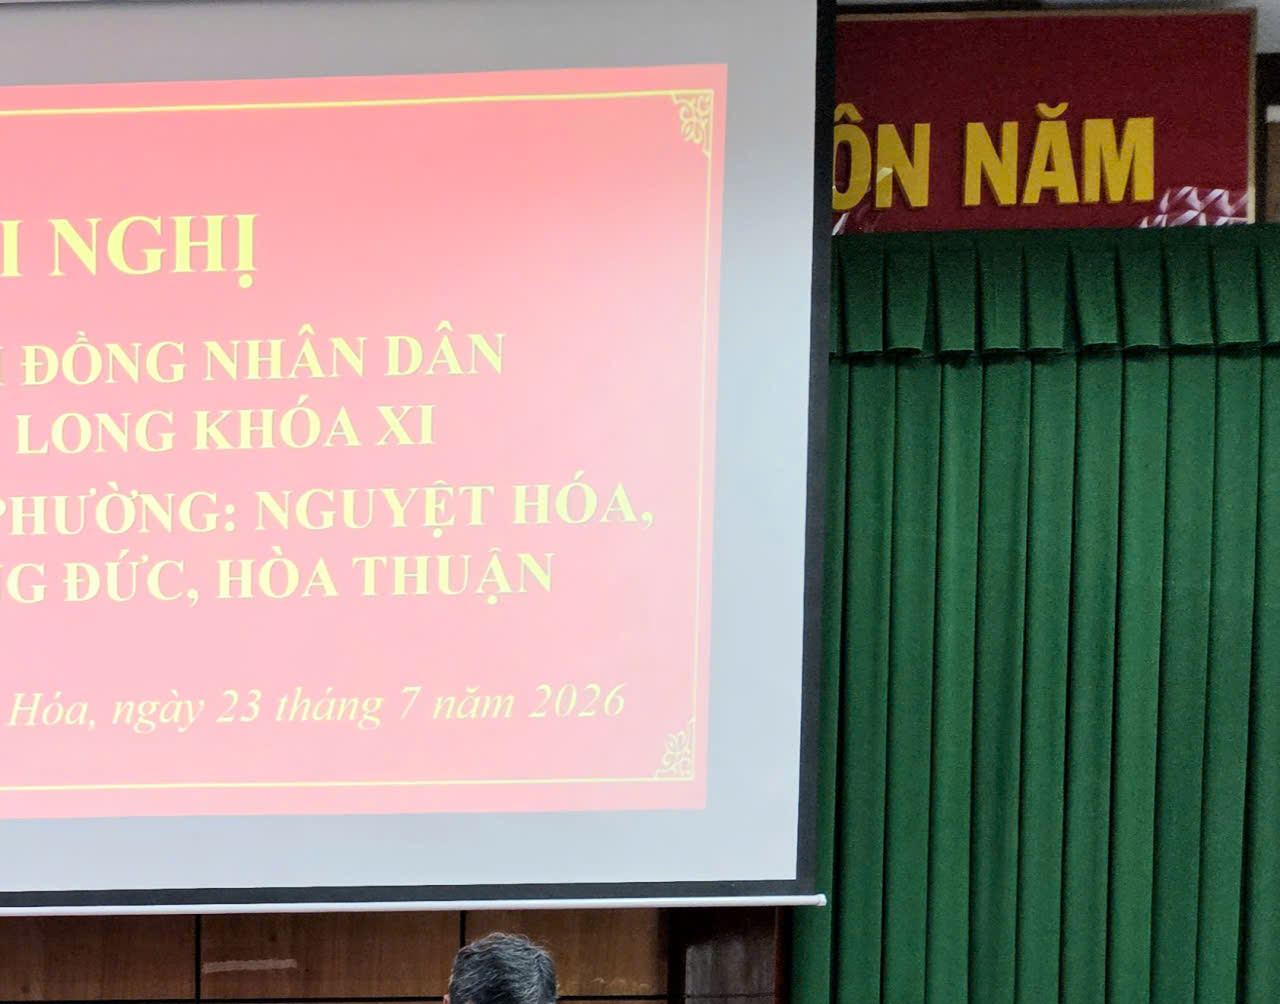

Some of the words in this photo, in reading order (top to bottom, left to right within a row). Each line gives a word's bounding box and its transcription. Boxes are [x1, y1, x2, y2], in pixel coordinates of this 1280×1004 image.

[962, 101, 1156, 209] NĂM
[47, 213, 260, 290] NGHỊ
[19, 330, 188, 386] ĐỒNG
[202, 323, 368, 382] NHÂN
[383, 319, 506, 378] DÂN
[15, 409, 177, 456] LONG
[193, 395, 362, 452] KHÓA
[375, 403, 437, 447] XI
[255, 479, 496, 540] NGUYỆT
[511, 470, 655, 531] HÓA,
[62, 548, 200, 608] ĐỨC,
[215, 545, 340, 600] HÒA
[352, 546, 556, 606] THUẬN
[7, 690, 97, 732] Hóa,
[111, 689, 205, 735] ngày
[215, 688, 262, 724] 23
[275, 685, 385, 730] tháng
[399, 685, 423, 720] 7
[432, 686, 515, 721] năm
[528, 682, 627, 720] 2026
